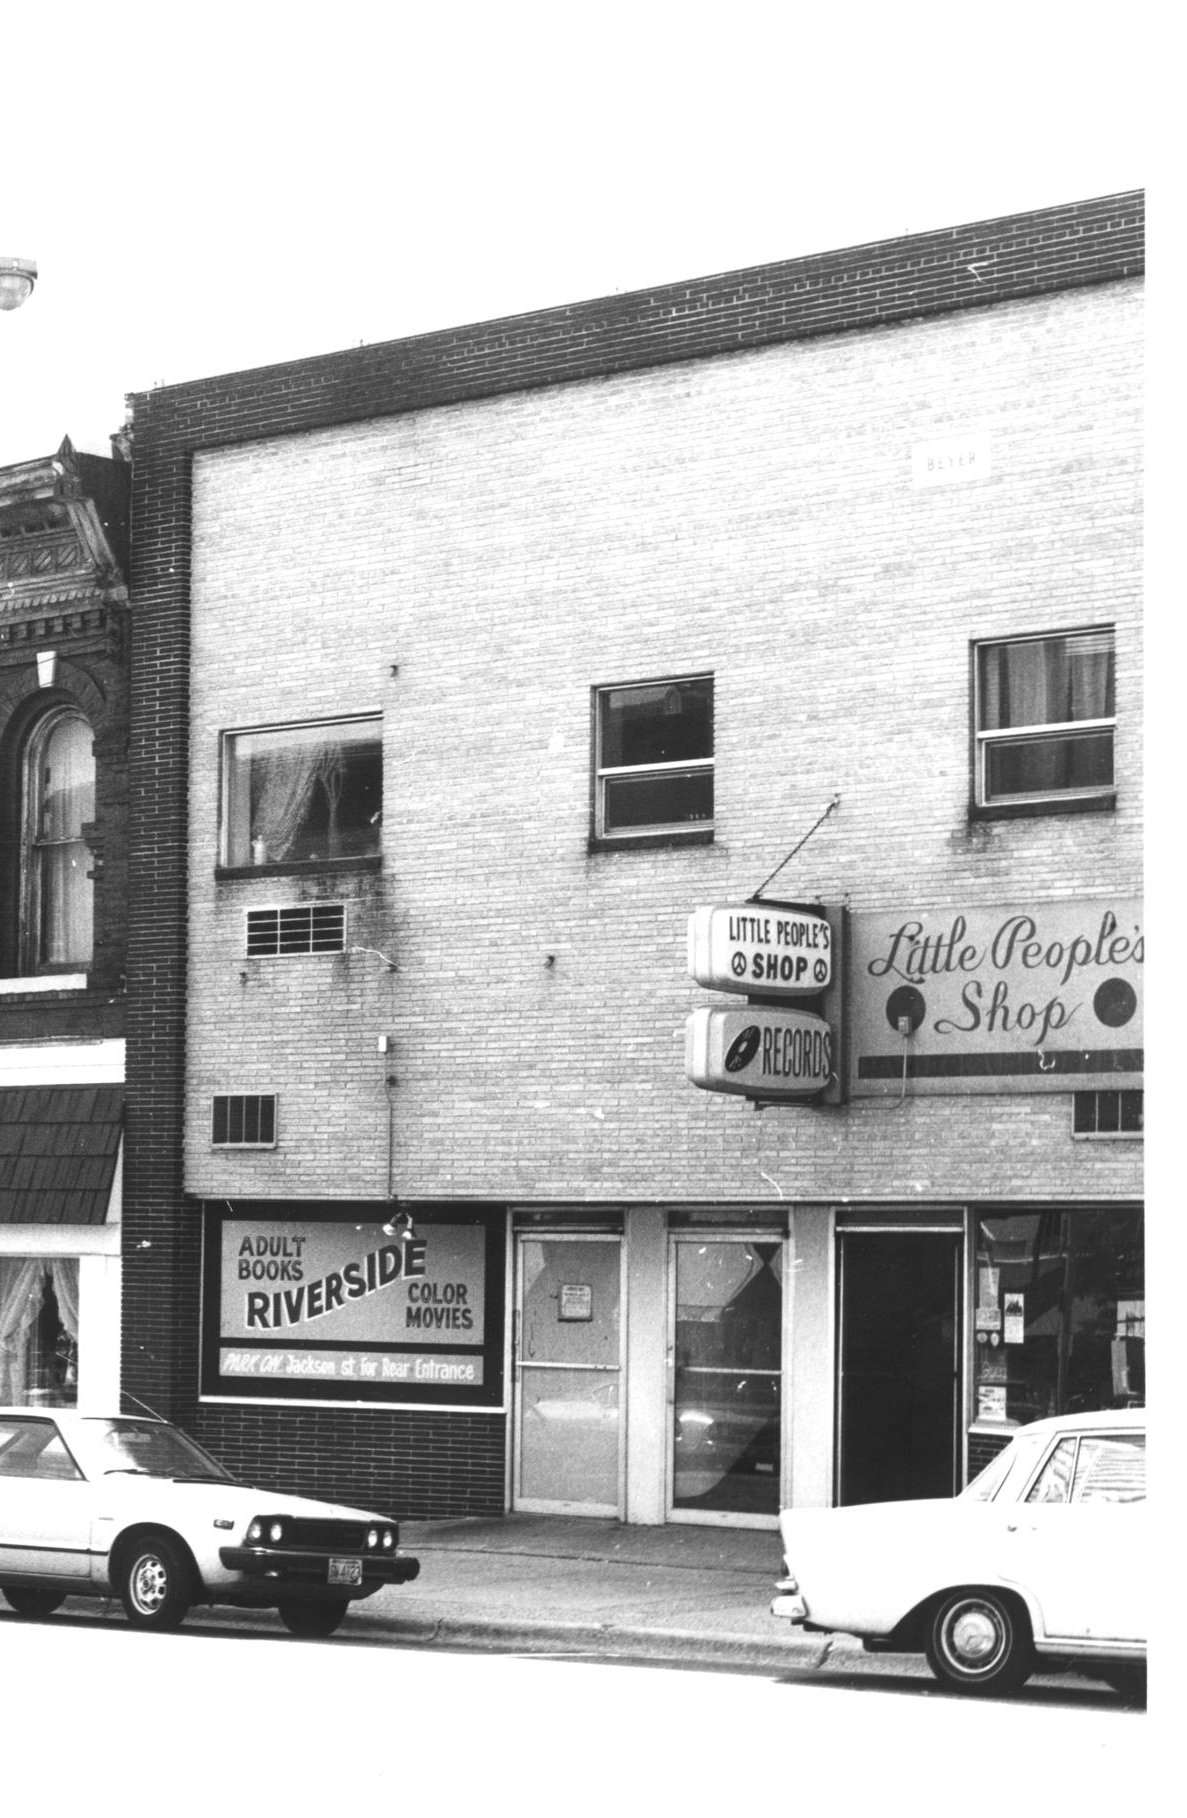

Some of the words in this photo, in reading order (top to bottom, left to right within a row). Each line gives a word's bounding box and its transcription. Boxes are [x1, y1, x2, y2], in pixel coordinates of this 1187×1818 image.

[728, 915, 771, 945] LITTLE
[776, 920, 831, 951] PEOPLE'S
[868, 915, 988, 984] Little
[991, 910, 1145, 986] People's
[752, 954, 808, 981] SHOP
[934, 980, 1083, 1044] Shop
[762, 1026, 831, 1079] RECORDS
[239, 1235, 306, 1257] ADULT
[238, 1259, 304, 1281] BOOKS
[246, 1239, 427, 1330] RIVERSIDE
[408, 1283, 468, 1305] COLOR
[405, 1307, 473, 1329] MOVIES
[223, 1352, 260, 1373] PARK
[286, 1354, 335, 1375] Jackson
[382, 1357, 410, 1378] Rear
[414, 1358, 475, 1381] Entrance
